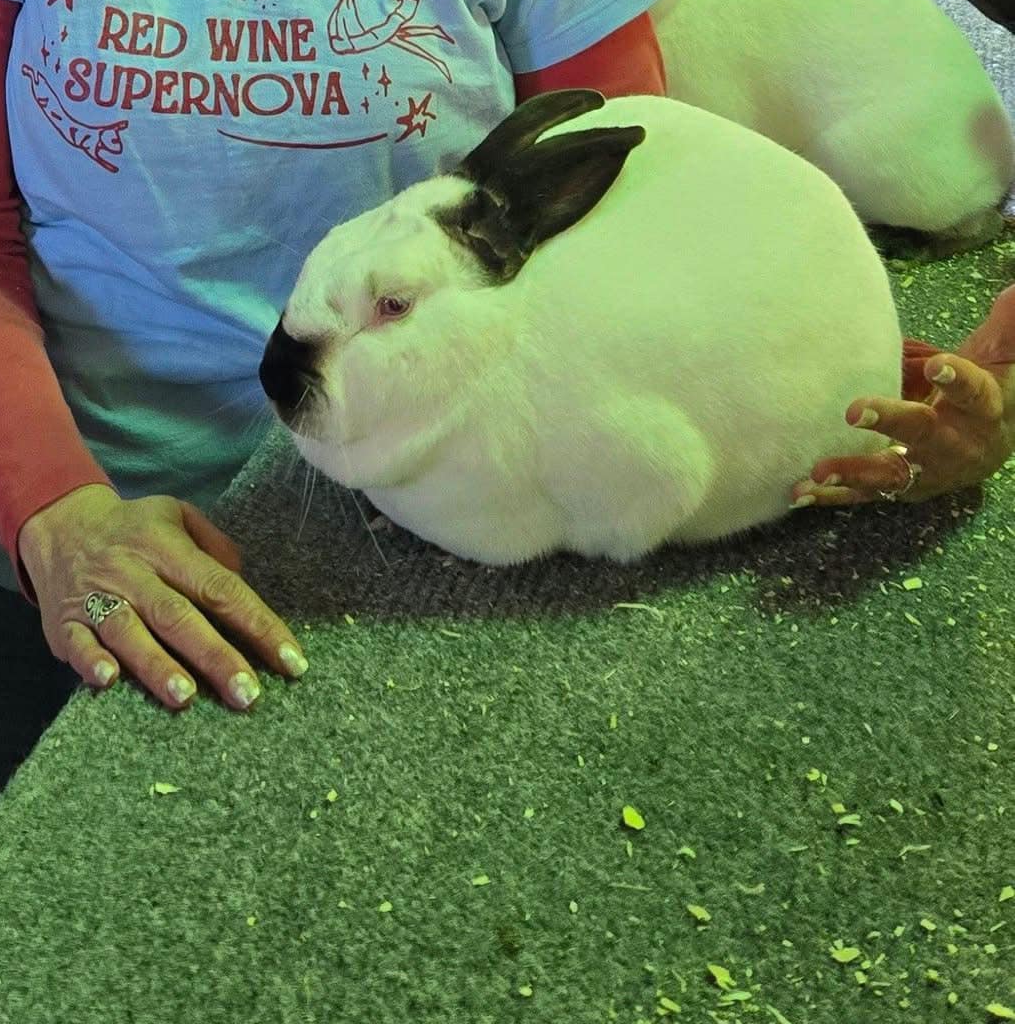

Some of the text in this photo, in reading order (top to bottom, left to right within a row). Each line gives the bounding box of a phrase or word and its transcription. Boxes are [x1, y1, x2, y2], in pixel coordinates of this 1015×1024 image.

[97, 7, 316, 61] RED WINE
[64, 58, 350, 116] SUPERNOVA
